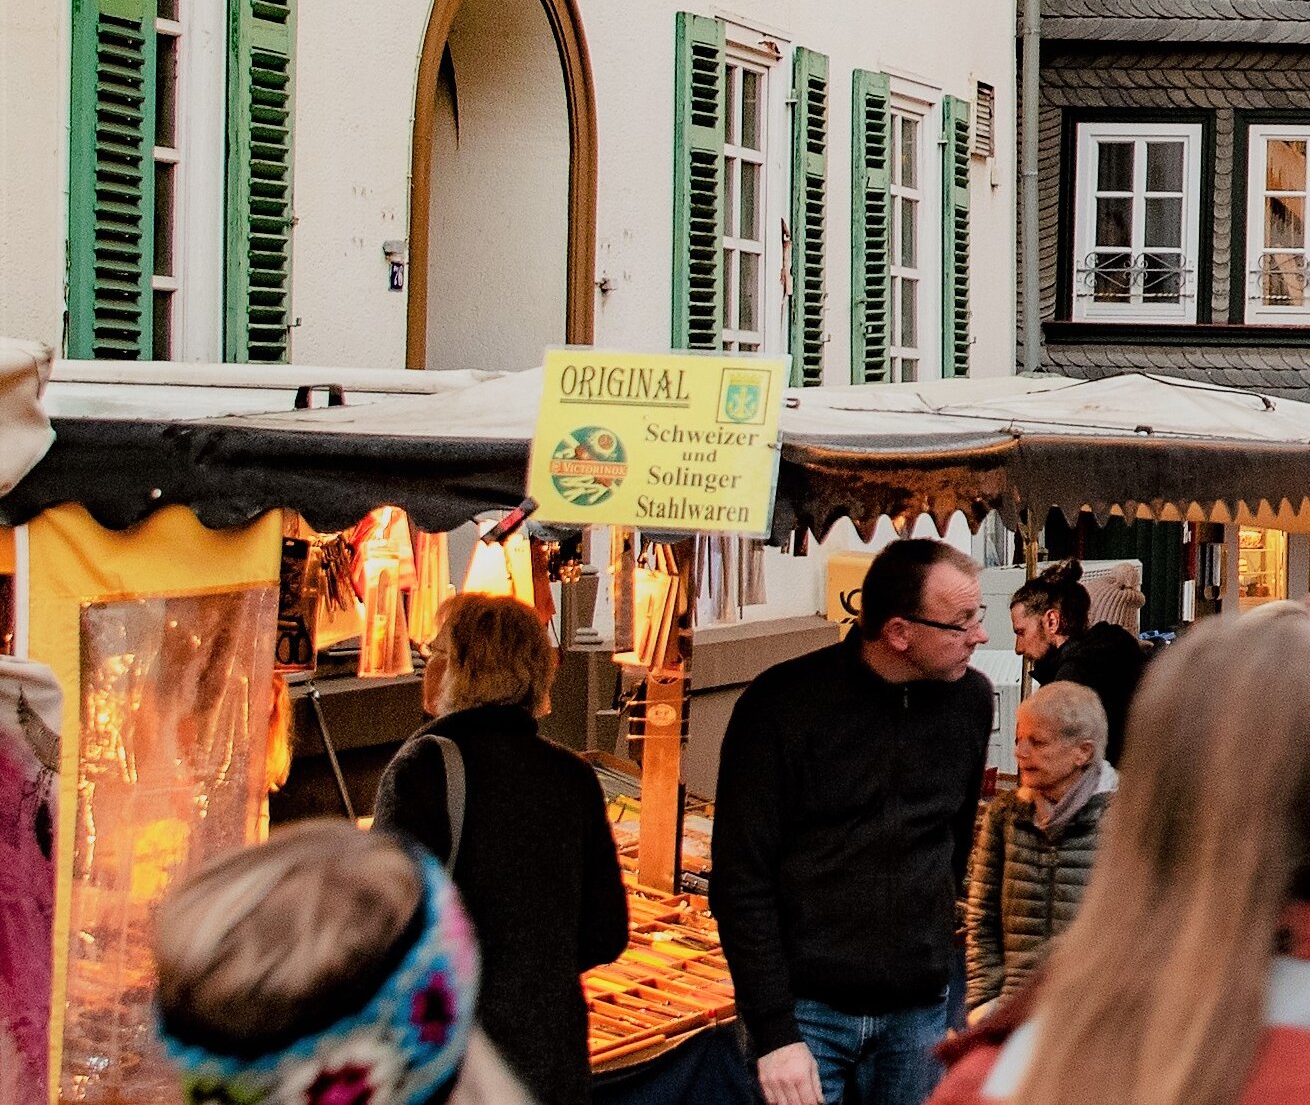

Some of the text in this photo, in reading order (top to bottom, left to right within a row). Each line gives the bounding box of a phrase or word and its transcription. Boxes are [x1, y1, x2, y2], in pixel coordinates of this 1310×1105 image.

[560, 365, 691, 401] ORIGINAL
[645, 423, 760, 447] Schweizer
[682, 449, 717, 463] und
[647, 466, 742, 494] Solinger
[635, 495, 750, 523] Stahlwaren
